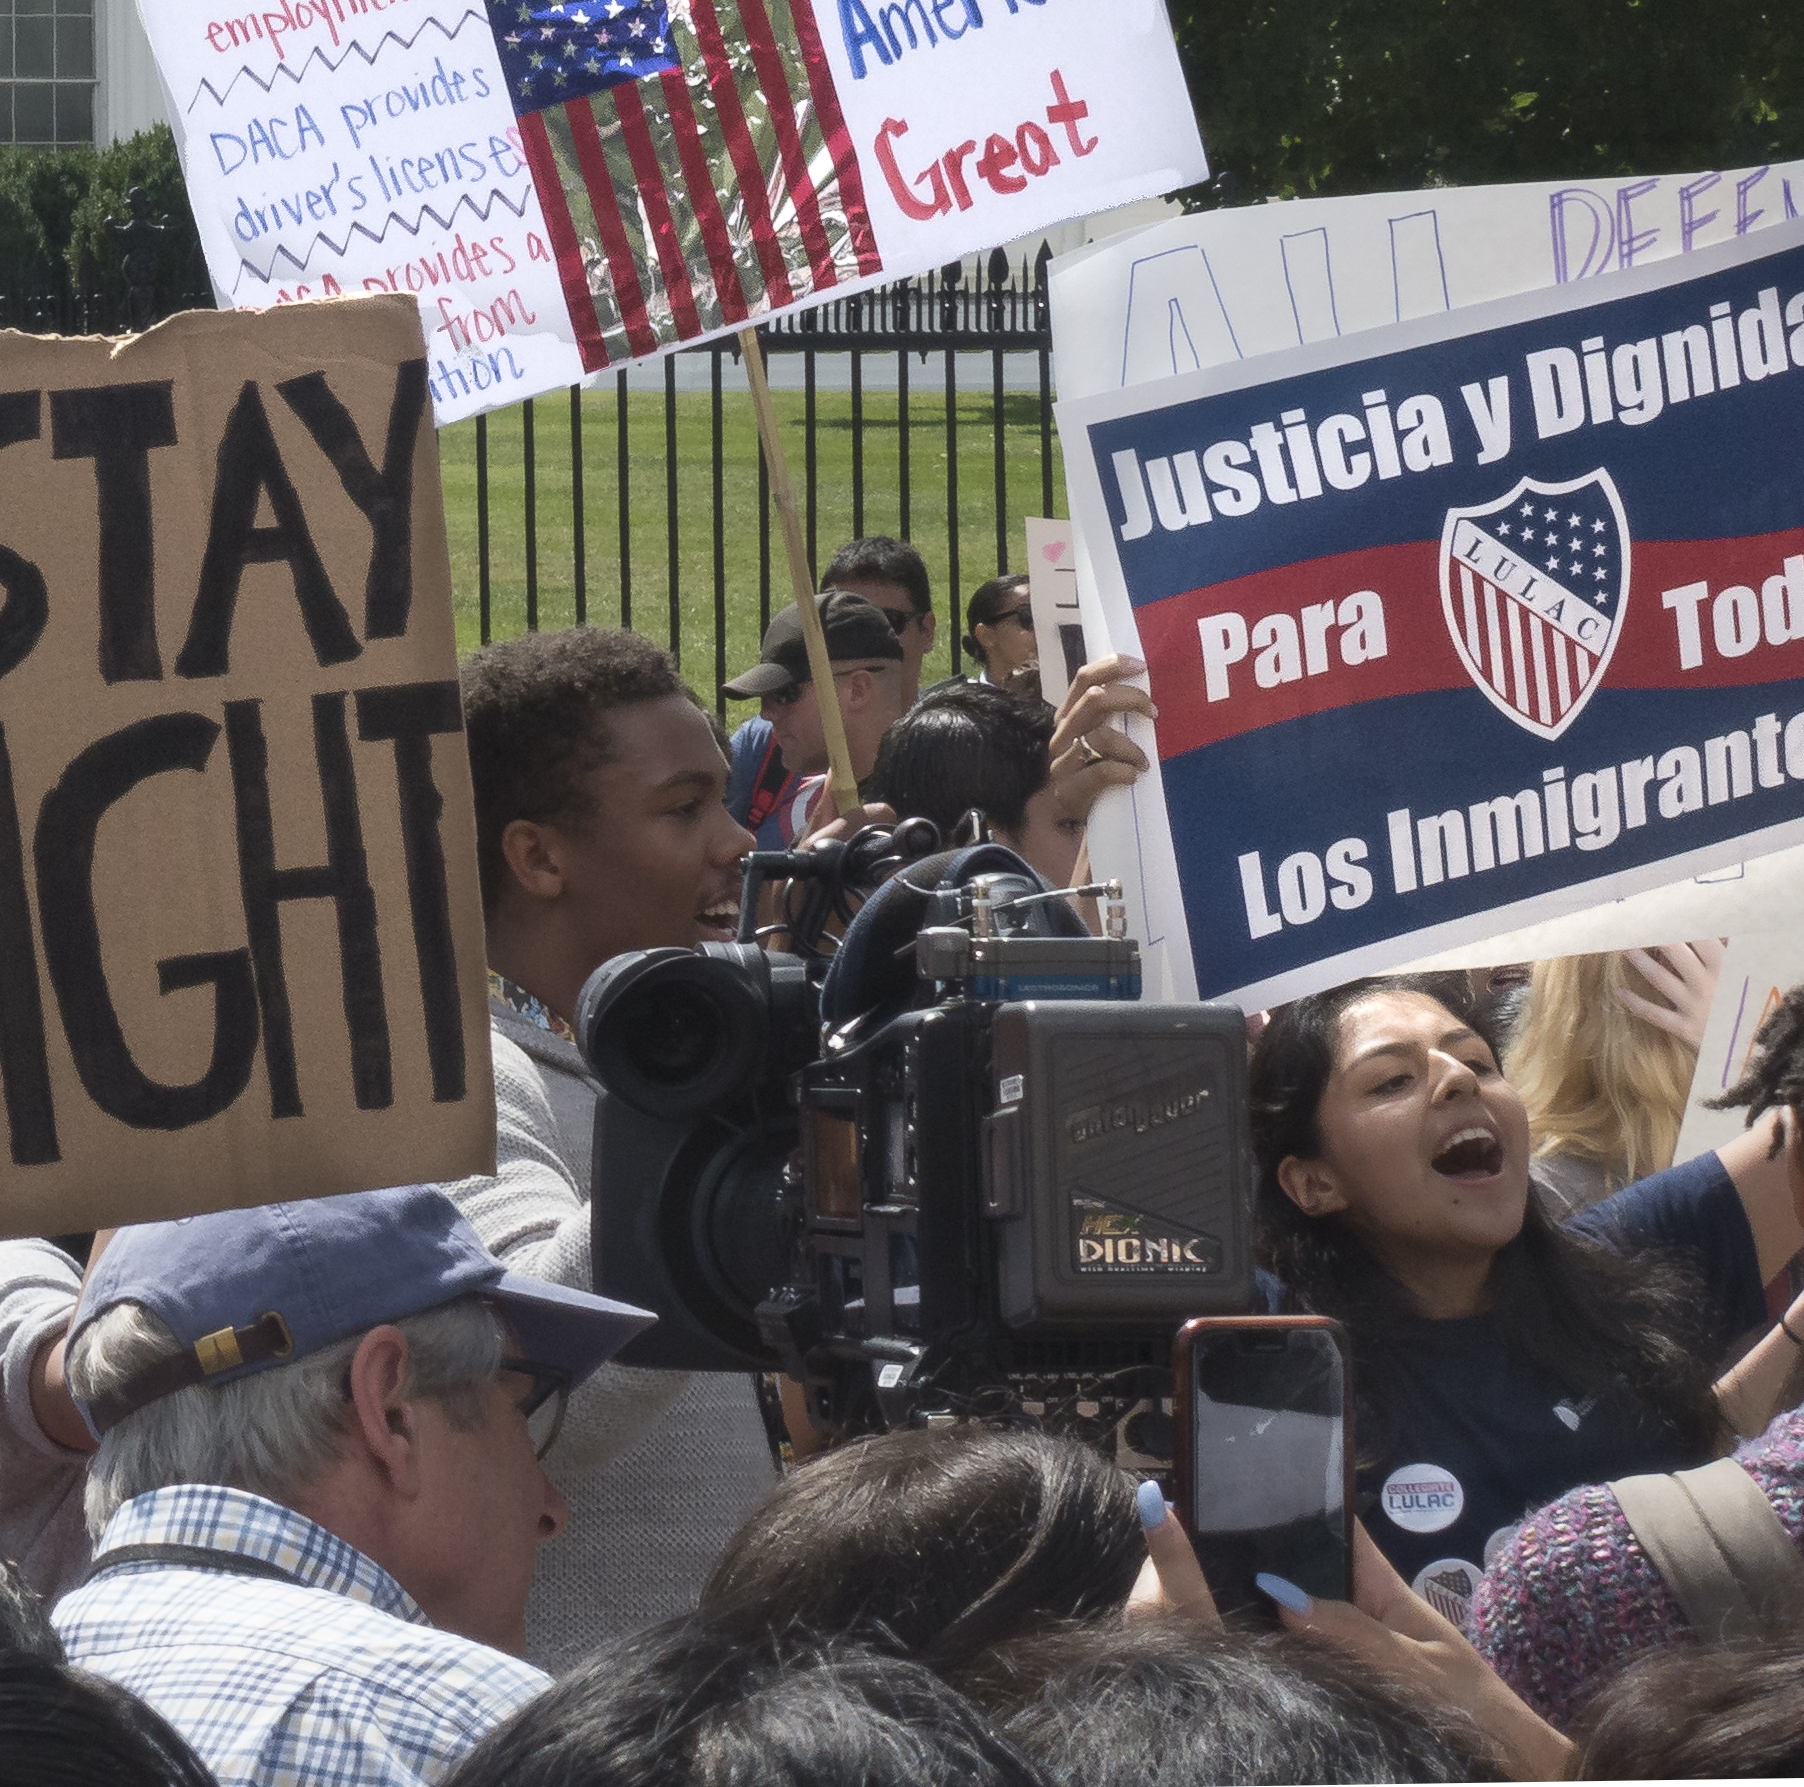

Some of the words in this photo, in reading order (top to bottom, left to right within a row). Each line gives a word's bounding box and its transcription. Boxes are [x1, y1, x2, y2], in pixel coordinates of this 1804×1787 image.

[210, 104, 324, 175] DACA
[340, 58, 490, 148] provides
[873, 68, 1098, 223] Great
[436, 289, 535, 353] from
[1113, 389, 1454, 542] Justicia
[1460, 374, 1511, 466] y
[1463, 537, 1601, 641] LULAC
[1198, 588, 1388, 703] Para
[1238, 837, 1373, 939] Los
[1388, 1494, 1455, 1510] LULAC
